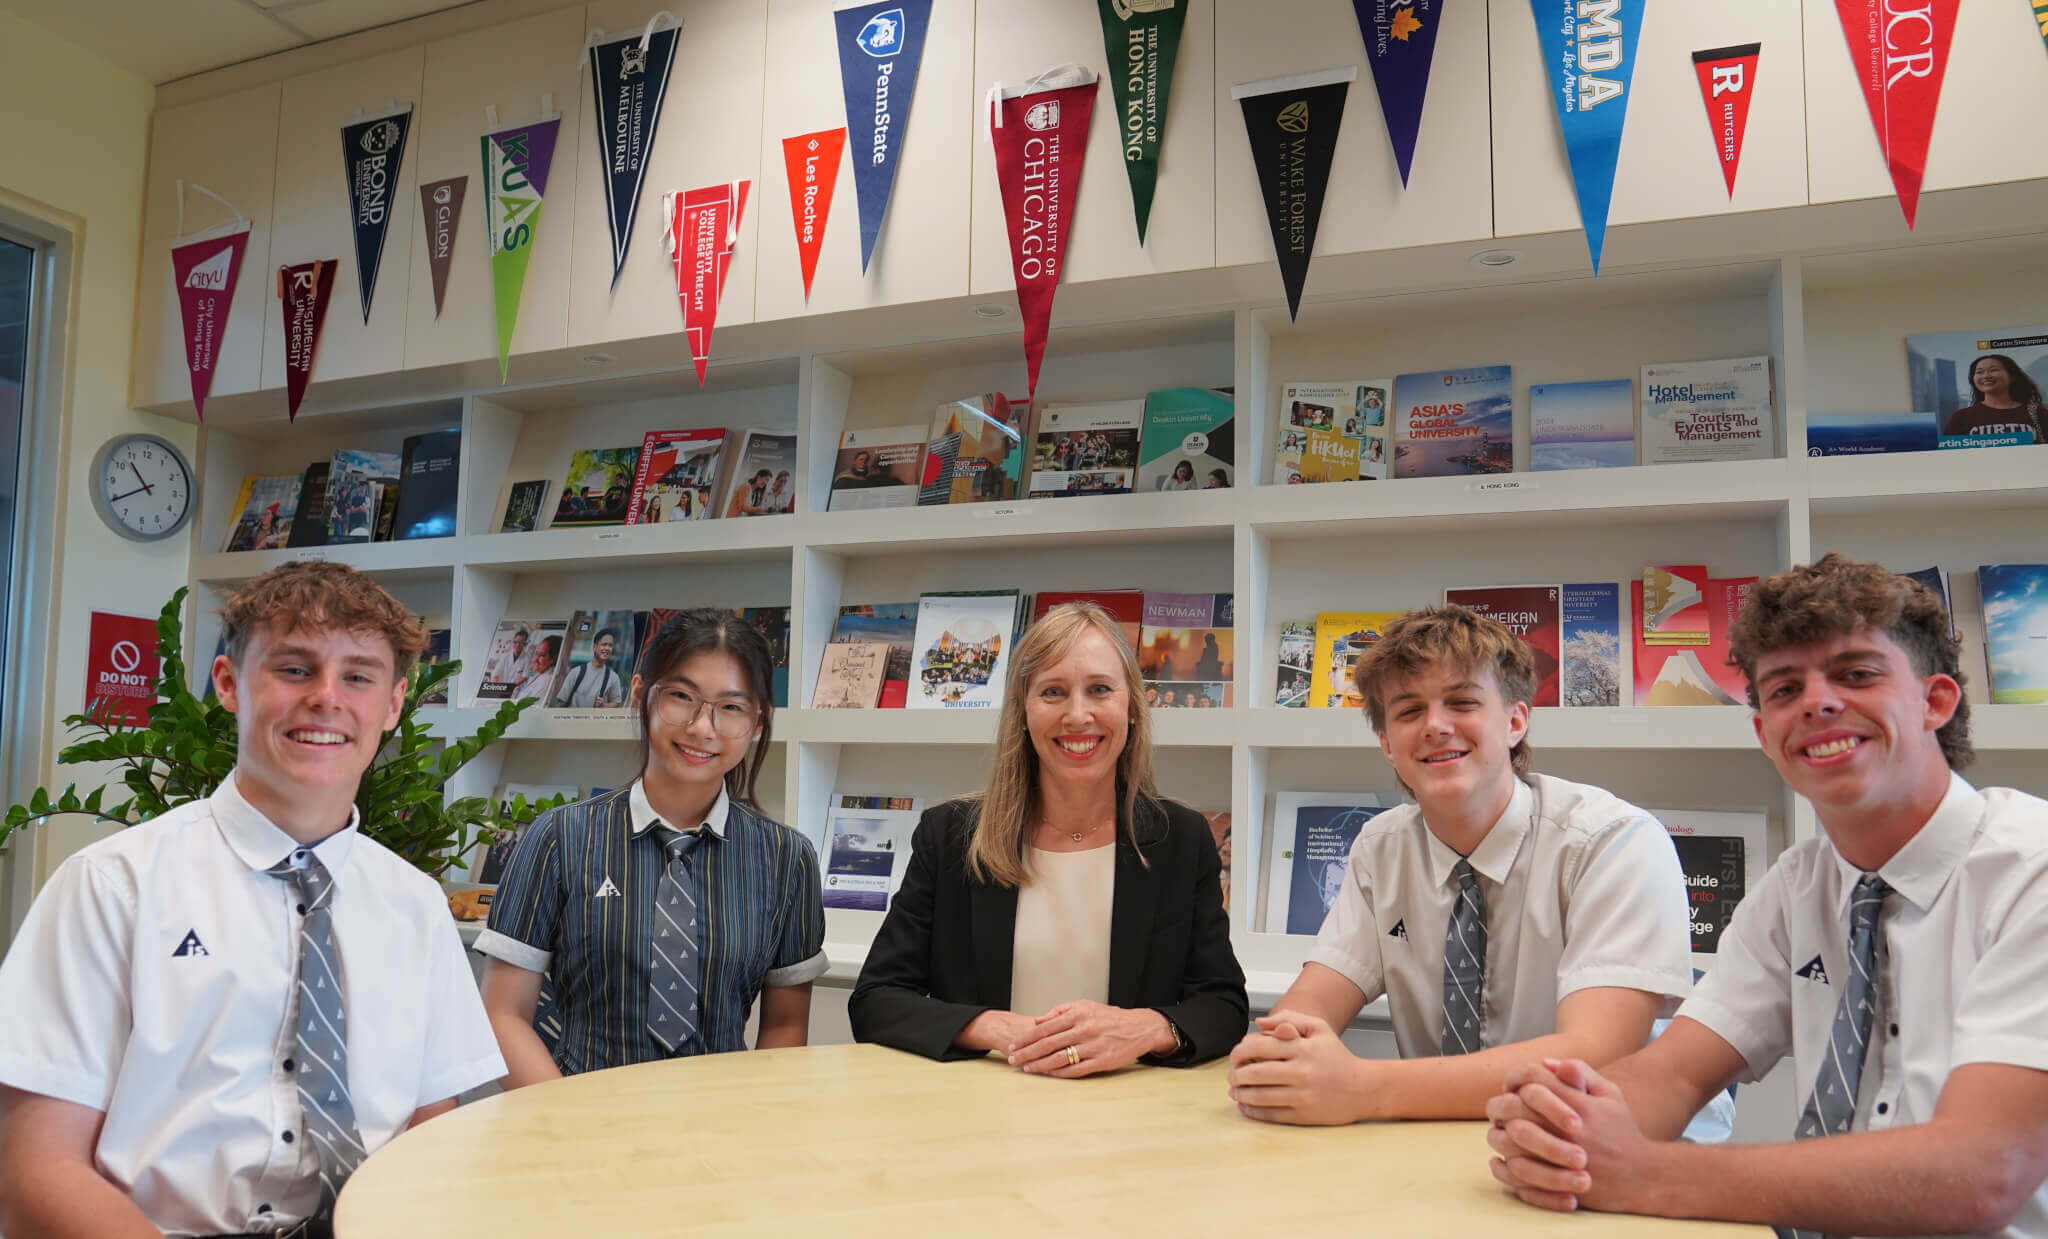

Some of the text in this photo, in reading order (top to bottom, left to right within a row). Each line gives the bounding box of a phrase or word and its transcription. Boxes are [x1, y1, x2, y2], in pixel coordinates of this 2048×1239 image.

[1868, 12, 1879, 43] College
[1146, 25, 1157, 143] THE UNIVERSITY OF
[1712, 63, 1744, 98] R
[1871, 48, 1882, 91] Roosevelt
[1126, 29, 1145, 162] HONG KONG
[1562, 70, 1576, 112] Angeles
[615, 85, 631, 174] MELBOURNE
[630, 81, 644, 170] THE UNIVERSITY OF
[872, 62, 893, 165] PennState
[1724, 103, 1735, 161] RUTGERS
[360, 158, 371, 226] UNIVERSITY
[369, 154, 387, 225] BOND
[498, 133, 530, 251] KUAS
[803, 156, 819, 244] Les Roches
[1046, 134, 1060, 276] THE UNIVERSITY OF
[1279, 143, 1288, 232] UNIVERSITY
[1290, 137, 1306, 254] WAKE FOREST
[1021, 138, 1045, 280] CHICAGO
[438, 206, 450, 259] GLION
[704, 208, 717, 274] UNIVERSITY
[694, 210, 708, 311] COLLEGE UTRECHT
[193, 300, 205, 372] of Hong Kong
[203, 298, 216, 370] City University
[289, 299, 304, 368] UNIVERSITY
[1410, 403, 1464, 418] ASIA'S
[1649, 384, 1693, 397] Hotel
[1655, 391, 1736, 404] Management
[1152, 412, 1212, 423] Deakin University
[1409, 418, 1458, 429] GLOBAL
[1409, 426, 1481, 439] UNIVERSITY
[1675, 417, 1758, 433] Events and
[1679, 429, 1761, 442] Management
[1690, 412, 1745, 423] Tourism
[128, 451, 136, 460] 11
[143, 450, 152, 459] 12
[1962, 437, 2018, 448] Singapore
[116, 461, 125, 470] 10
[169, 473, 174, 481] 2
[637, 443, 654, 485] GRIFFITH
[1148, 605, 1206, 617] NEWMAN
[100, 671, 147, 686] DO NOT
[481, 682, 508, 692] Science
[944, 700, 992, 709] UNIVERSITY
[1721, 838, 1742, 891] First
[1691, 890, 1715, 903] into
